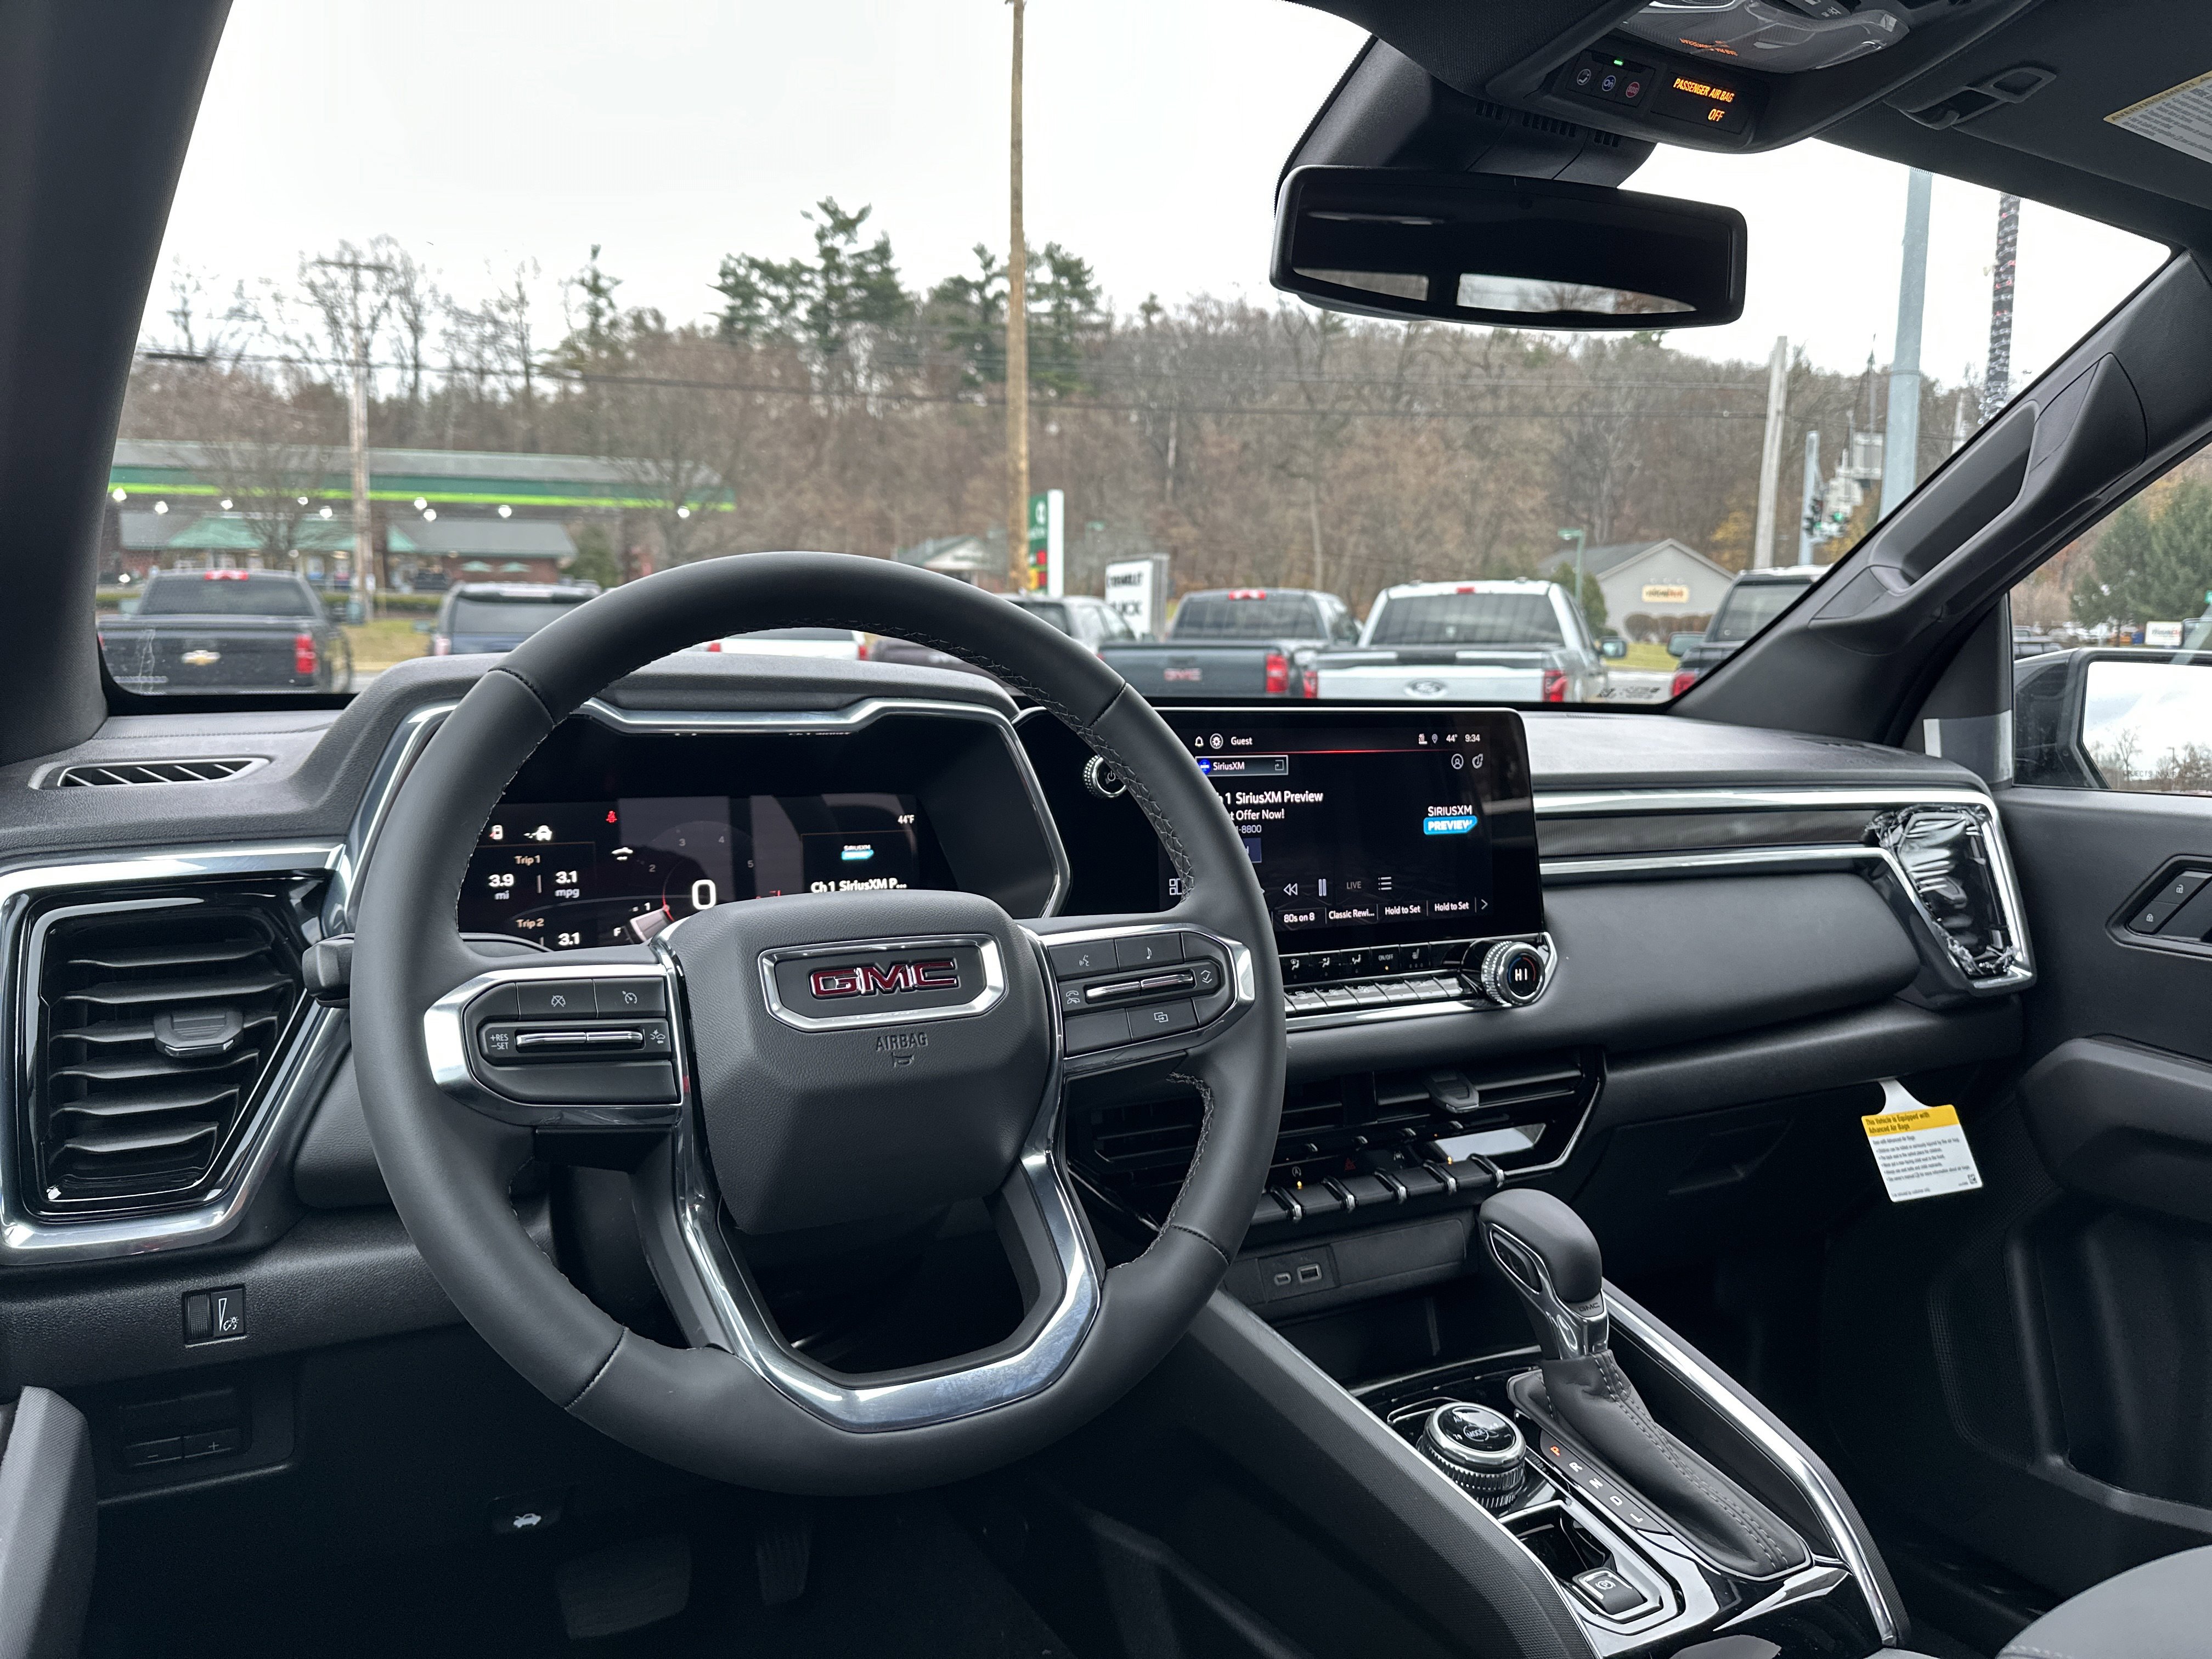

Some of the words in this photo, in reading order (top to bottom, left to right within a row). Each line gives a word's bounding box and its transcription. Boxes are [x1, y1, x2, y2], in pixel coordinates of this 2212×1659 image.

[1628, 86, 1639, 94] SOS
[1673, 78, 1711, 97] PASSENGER
[1708, 88, 1723, 99] AIR
[1719, 91, 1735, 103] BAG
[1708, 109, 1725, 122] OFF
[1231, 736, 1253, 746] Guest
[1465, 733, 1480, 742] 9:34
[1212, 761, 1245, 771] SiriusXM
[1225, 792, 1231, 804] 1
[1235, 791, 1282, 805] SiriusXM
[1283, 790, 1323, 803] Preview
[1235, 809, 1261, 821] Offer
[1261, 808, 1285, 820] Now!
[1427, 804, 1472, 817] SIRIUSXM
[1427, 819, 1473, 831] PREVIEW
[679, 838, 686, 847] 3
[514, 855, 534, 866] Trip
[534, 855, 541, 864] 1
[747, 860, 754, 868] 5
[648, 864, 657, 872] 2
[488, 873, 515, 887] 3.9
[555, 871, 577, 883] 3.1
[811, 881, 827, 893] Ch
[828, 881, 836, 891] 1
[839, 878, 887, 891] SiriusXM
[1346, 881, 1362, 890] LIVE
[494, 890, 510, 900] mi
[555, 888, 579, 898] mpg
[691, 879, 716, 910] 0
[1385, 906, 1401, 915] Hold
[1409, 905, 1421, 913] Set
[1434, 902, 1449, 911] Hold
[1458, 901, 1469, 910] Set
[1283, 914, 1298, 923] 80s
[1309, 912, 1316, 921] 8
[1328, 910, 1352, 919] Classic
[516, 919, 535, 929] Trip
[536, 918, 544, 927] 2
[613, 927, 621, 936] F
[558, 932, 580, 945] 3.1
[810, 960, 958, 997] GMC
[1515, 968, 1528, 981] HI
[876, 1032, 928, 1052] AIRBAG
[1579, 1302, 1600, 1312] GMC
[1466, 1428, 1486, 1437] MODE
[1550, 1446, 1560, 1457] P
[1569, 1462, 1583, 1472] R
[1589, 1478, 1604, 1489] N
[1610, 1496, 1623, 1506] D
[1630, 1513, 1644, 1523] L
